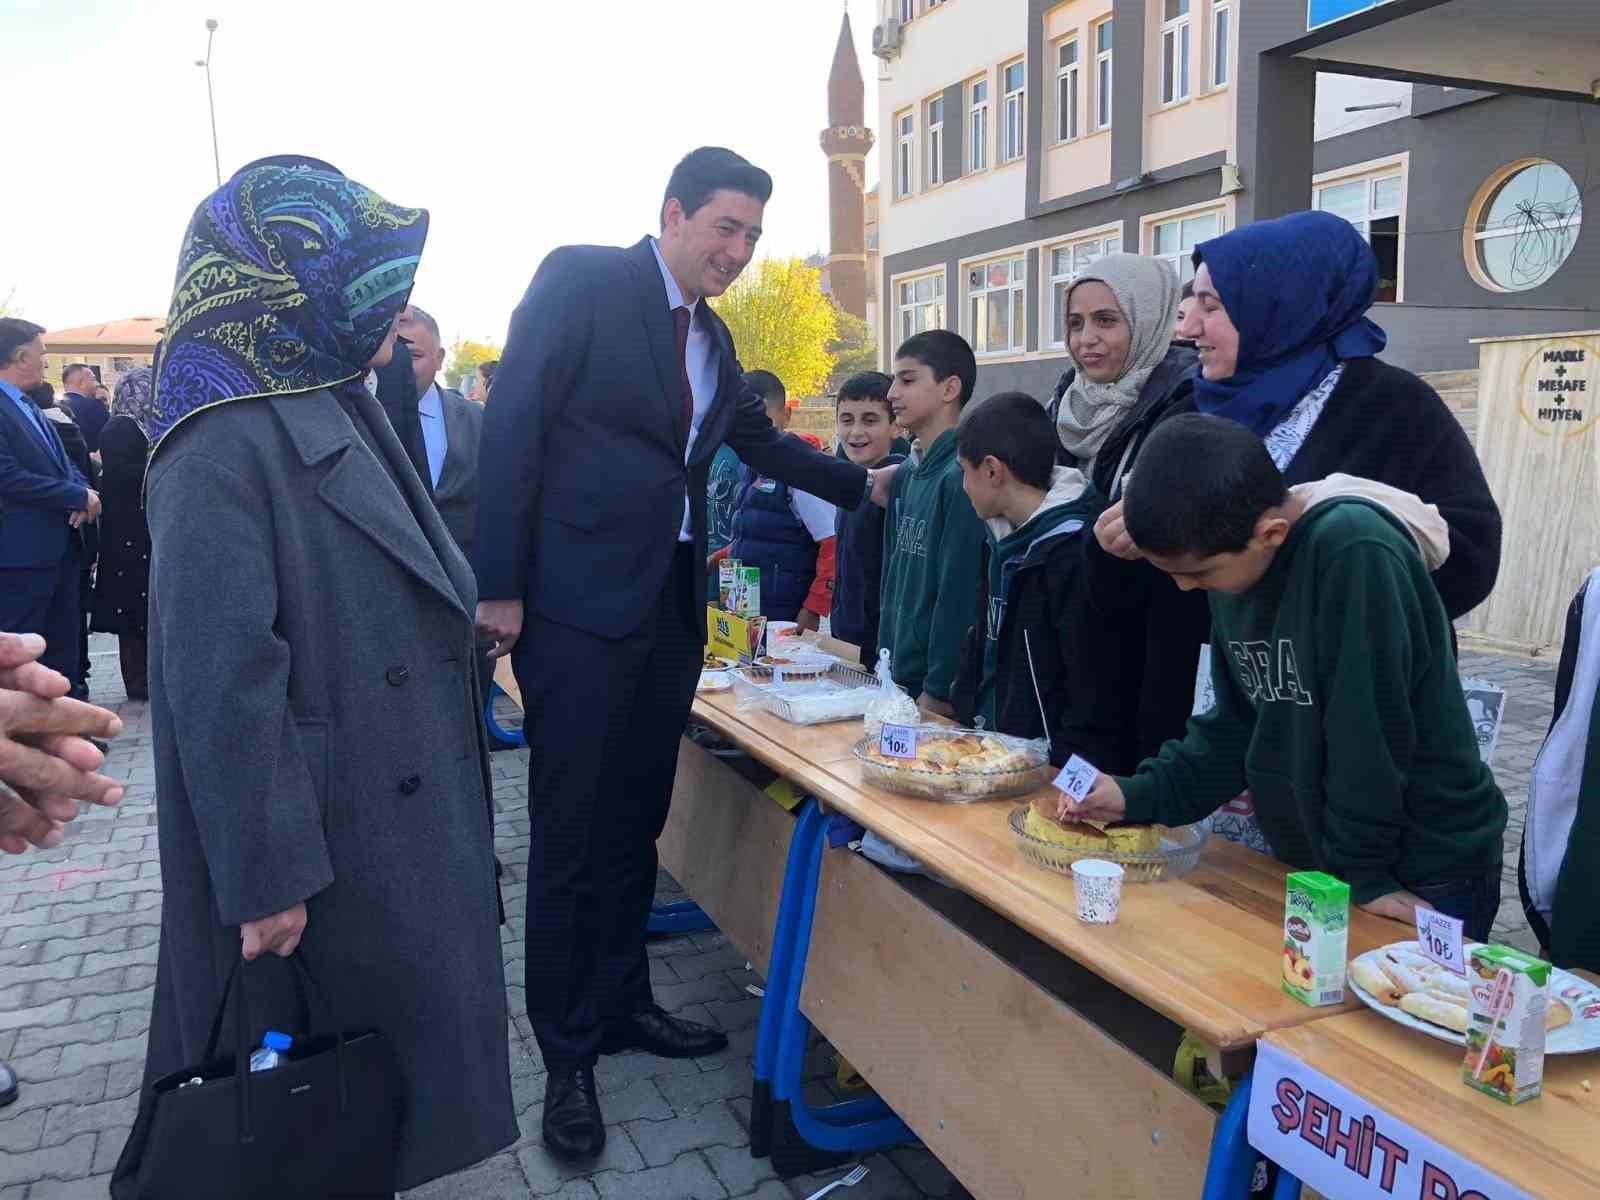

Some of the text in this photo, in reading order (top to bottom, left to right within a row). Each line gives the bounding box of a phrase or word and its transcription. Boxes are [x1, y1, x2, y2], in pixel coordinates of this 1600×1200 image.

[1544, 350, 1585, 362] MASKE
[1538, 380, 1586, 391] MESAFE
[1272, 1077, 1408, 1194] ŞEHİT
